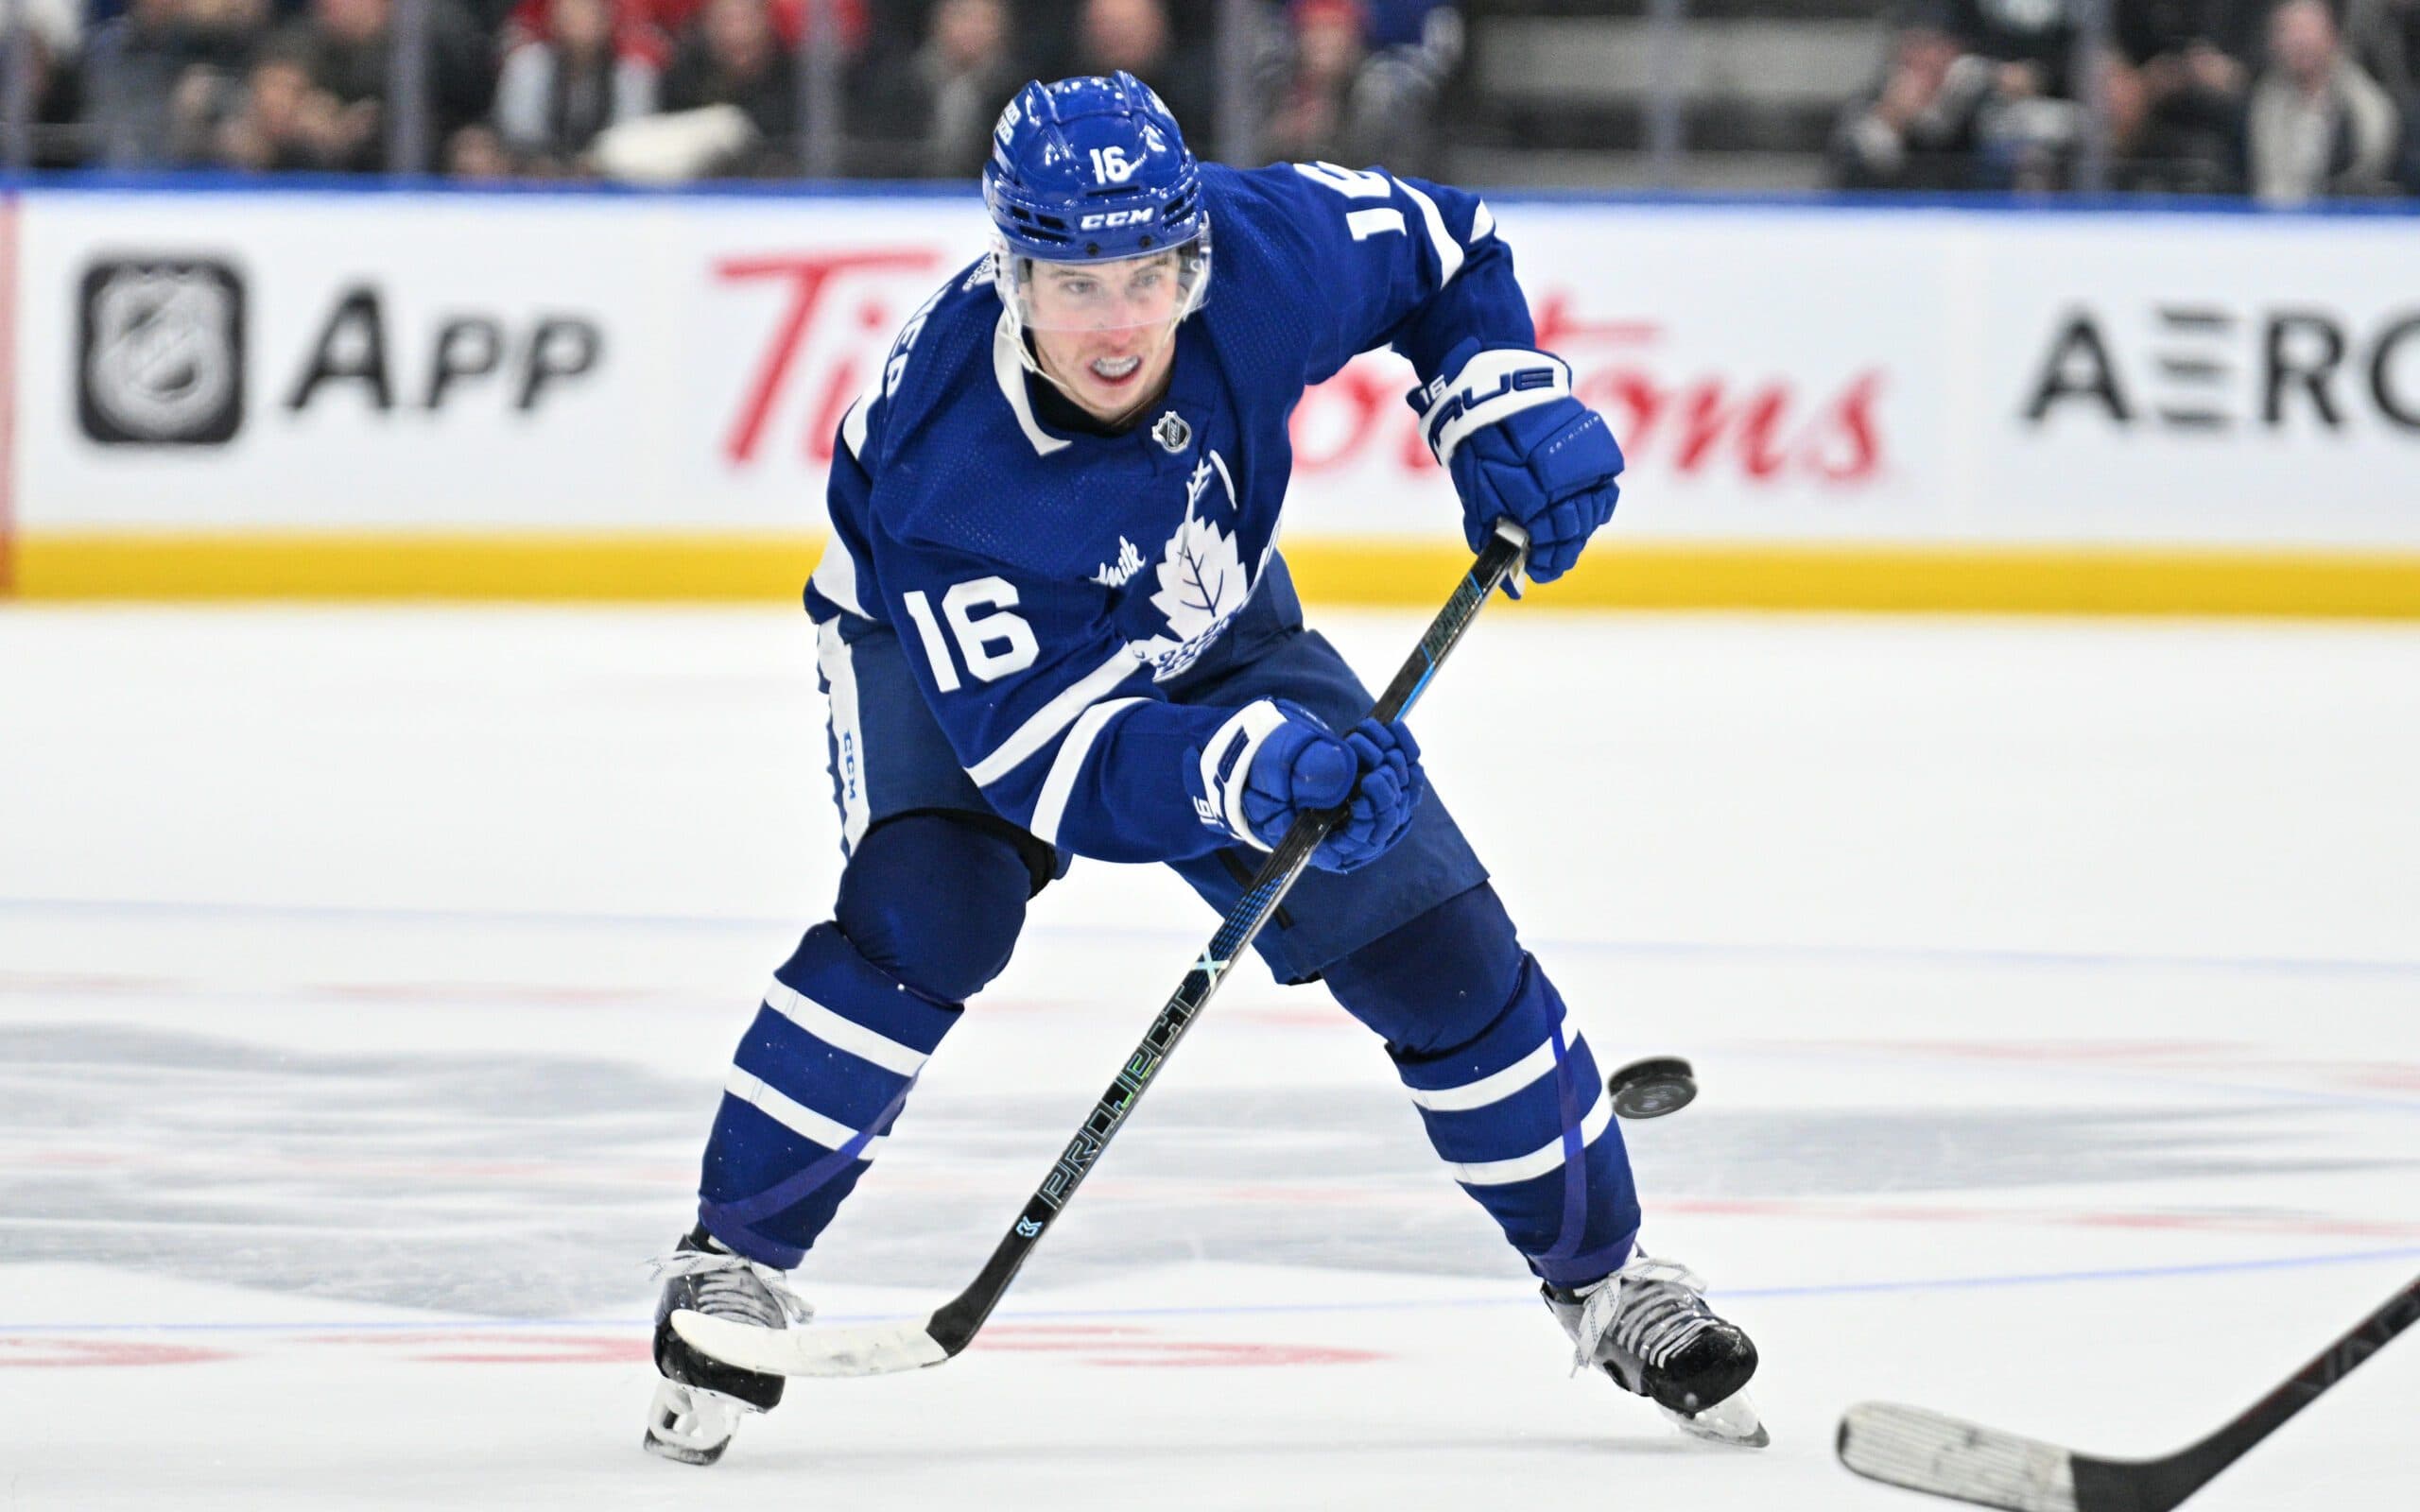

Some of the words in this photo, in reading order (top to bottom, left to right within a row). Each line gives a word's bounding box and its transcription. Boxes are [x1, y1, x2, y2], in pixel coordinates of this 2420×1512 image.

[1089, 146, 1132, 184] 16
[1080, 206, 1155, 232] CCM
[1420, 374, 1449, 407] 16
[904, 576, 1040, 693] 16
[843, 729, 856, 800] CCM
[1036, 985, 1197, 1211] PROJECT
[1190, 943, 1230, 993] X
